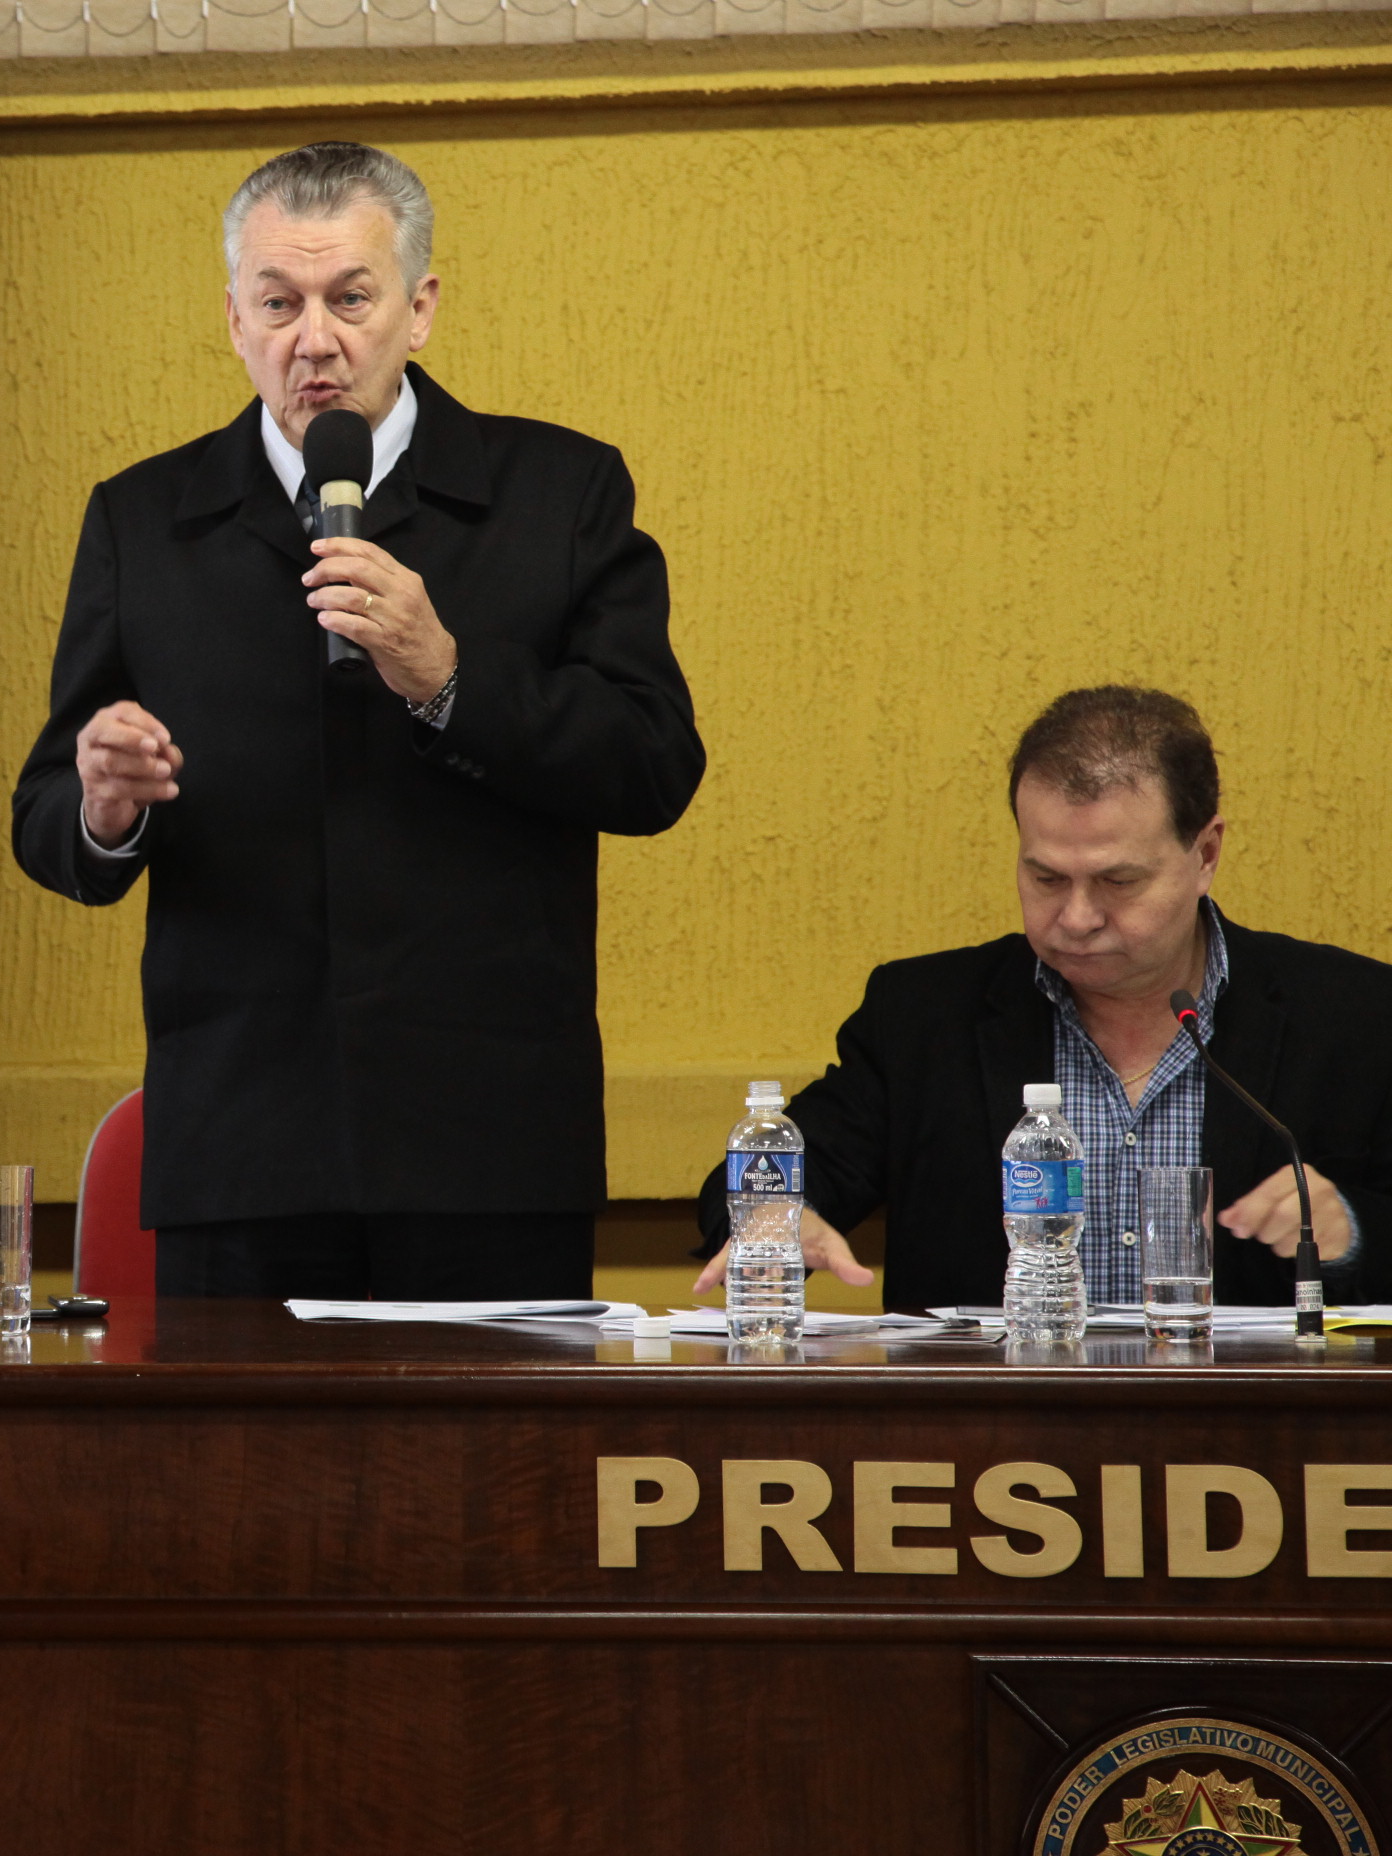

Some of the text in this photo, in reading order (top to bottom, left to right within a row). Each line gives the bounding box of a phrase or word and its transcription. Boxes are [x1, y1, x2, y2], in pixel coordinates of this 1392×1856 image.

[596, 1456, 1392, 1578] PRESIDE
[1048, 1727, 1364, 1844] PODER LEGISLATIVO MUNICIPAL
